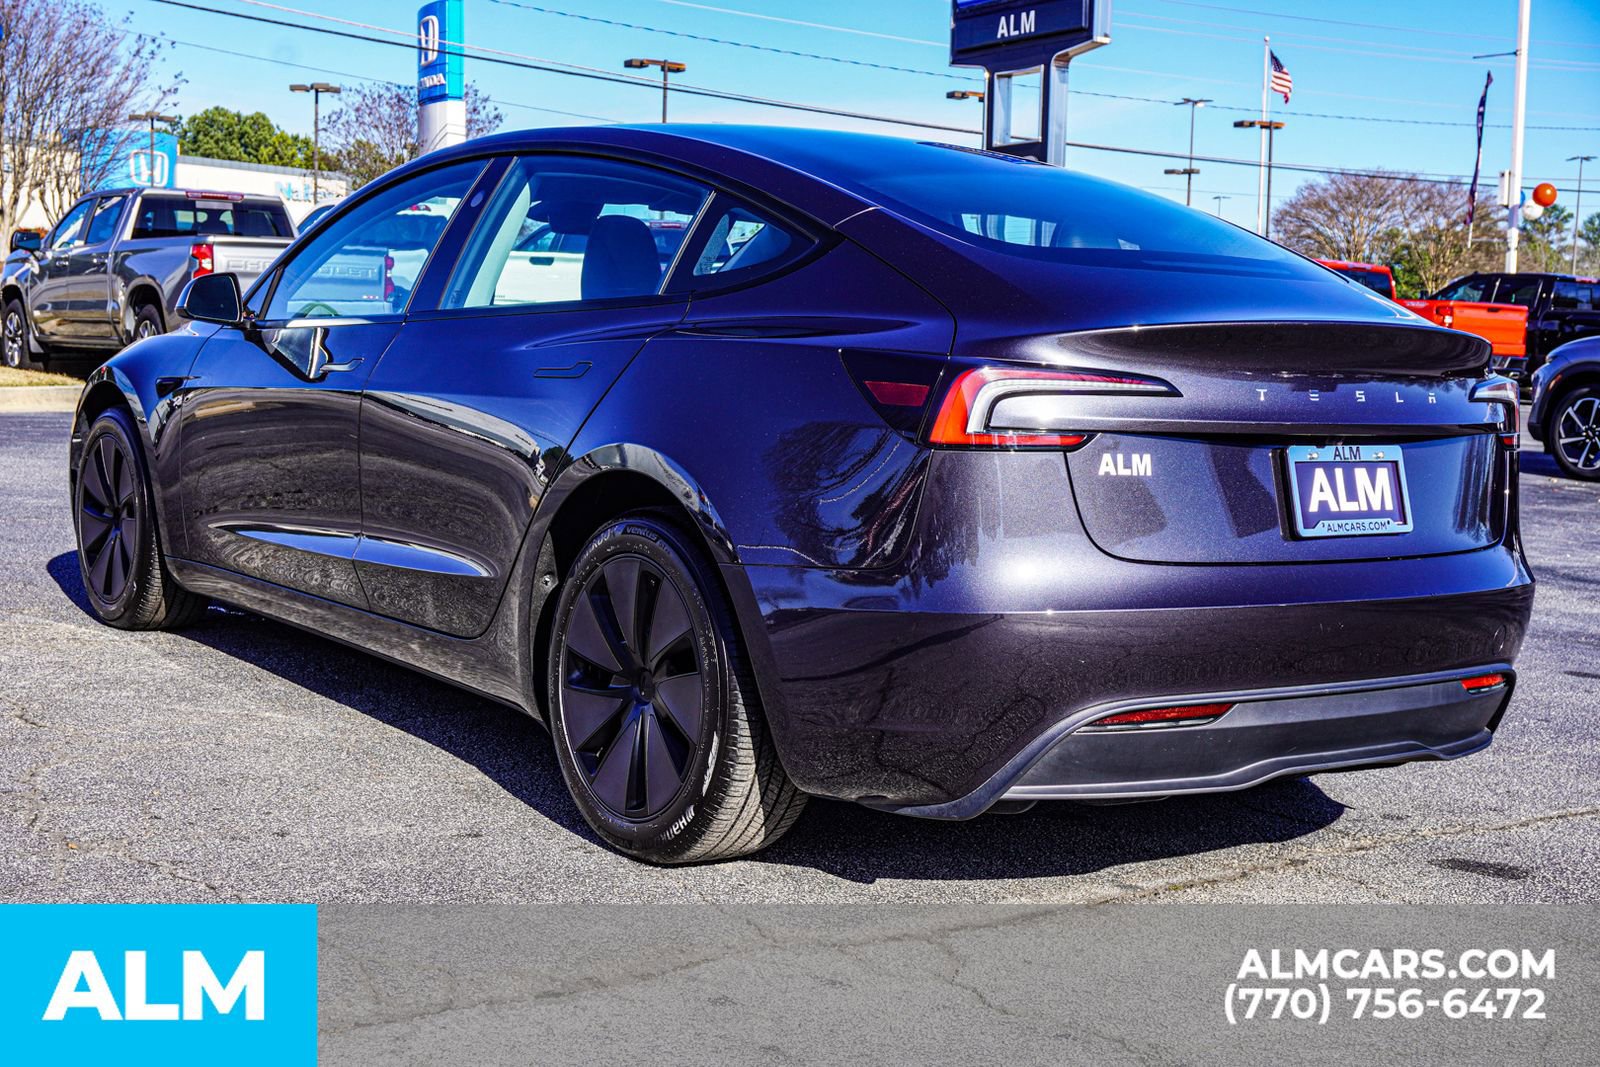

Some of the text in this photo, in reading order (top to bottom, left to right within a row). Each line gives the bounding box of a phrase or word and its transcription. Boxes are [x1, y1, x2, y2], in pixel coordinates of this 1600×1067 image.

[997, 10, 1036, 39] ALM
[1255, 388, 1437, 404] TESLA
[1333, 446, 1361, 461] ALM
[1098, 453, 1152, 476] ALM
[1308, 467, 1394, 512] ALM
[1326, 521, 1388, 533] ALMCARS.COM
